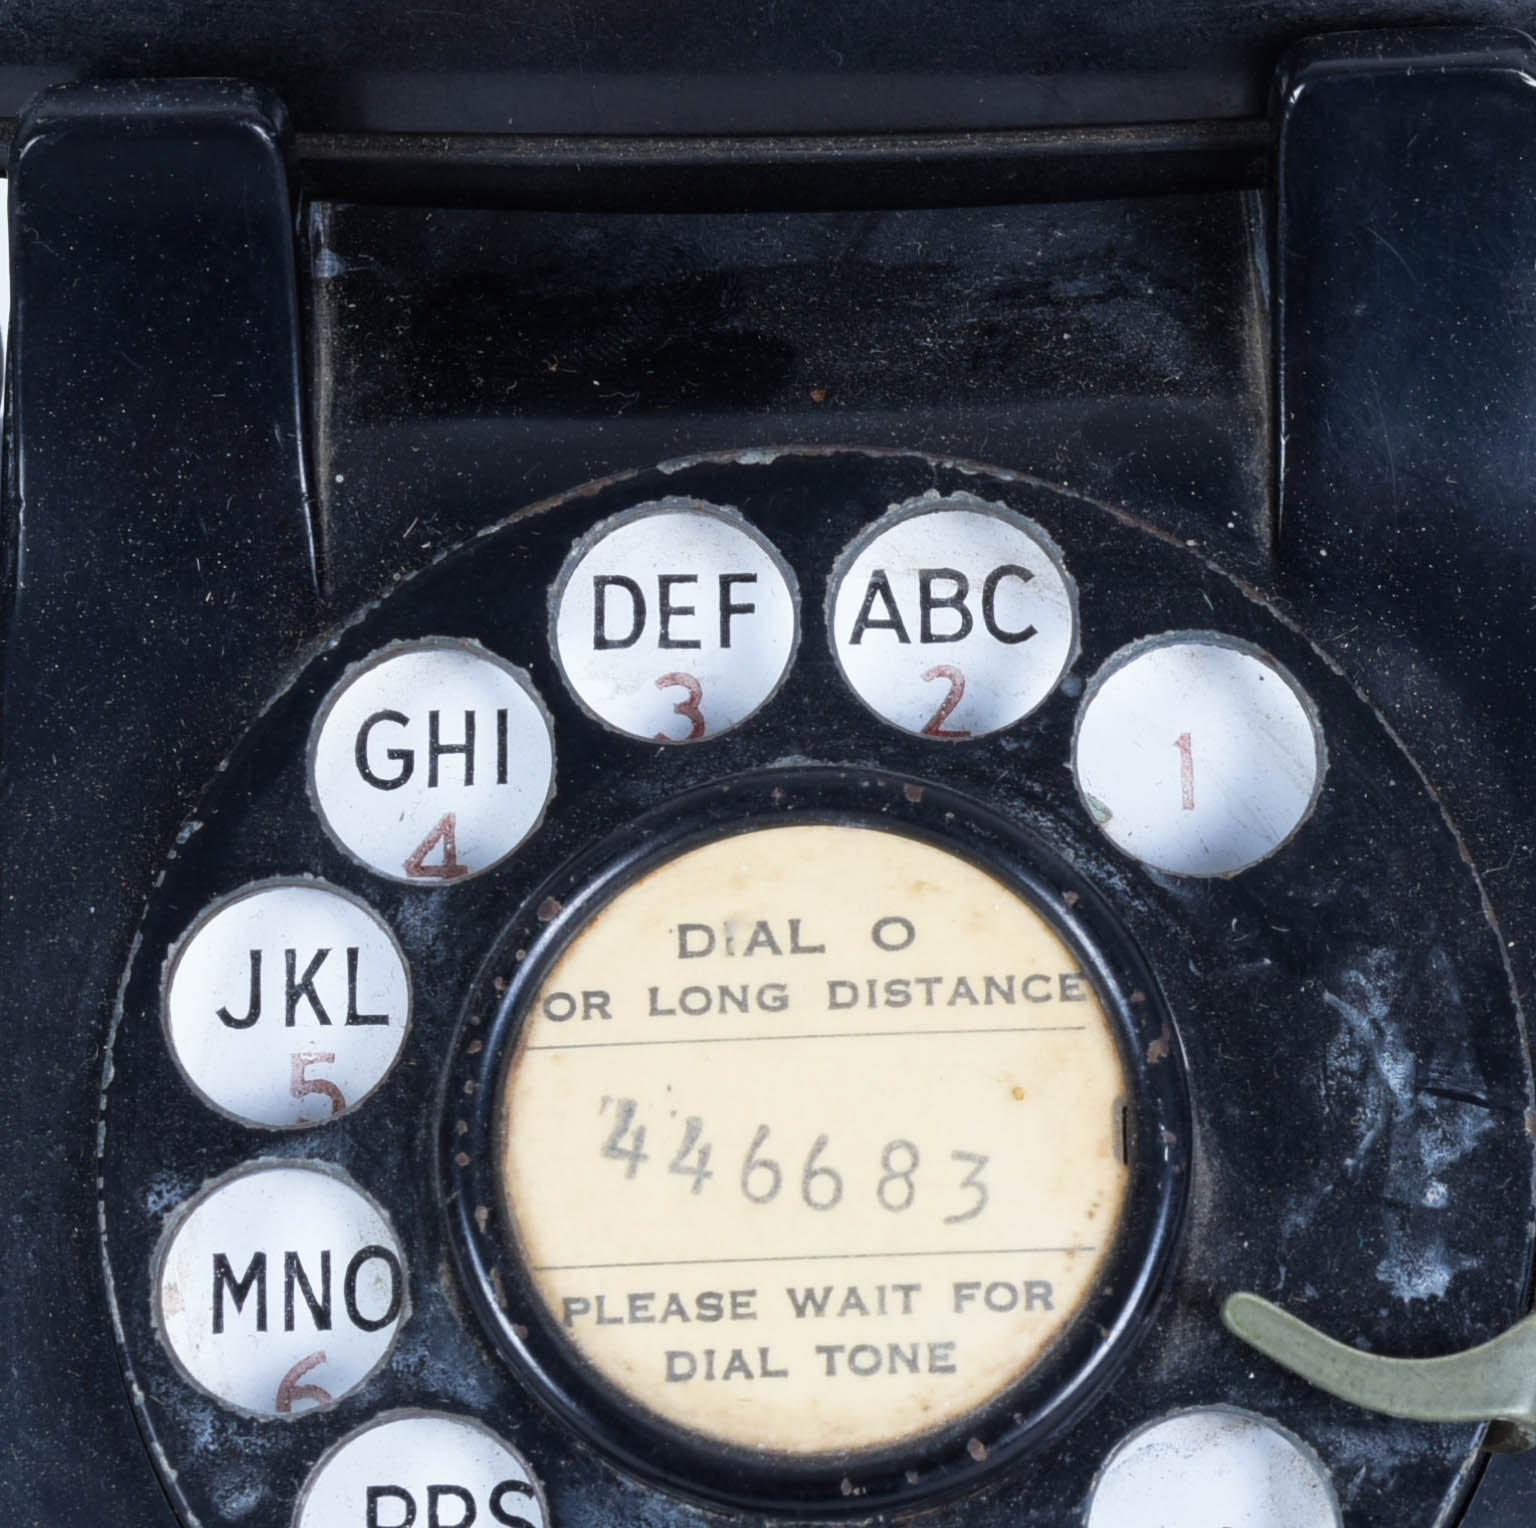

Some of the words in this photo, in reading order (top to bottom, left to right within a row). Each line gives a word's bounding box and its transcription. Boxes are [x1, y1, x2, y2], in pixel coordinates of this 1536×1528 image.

[593, 572, 758, 650] DEF
[849, 564, 1038, 646] ABC
[656, 672, 705, 741] 3
[921, 665, 971, 739] 2
[355, 708, 509, 792] GHI
[1173, 732, 1196, 812] 1
[403, 812, 469, 878] 4
[676, 918, 825, 960] DIAL
[216, 947, 390, 1030] JKL
[648, 983, 789, 1017] LONG
[827, 972, 1088, 1011] DISTANCE
[290, 1052, 346, 1124] 5
[600, 1096, 991, 1225] 446683
[212, 1244, 402, 1334] MNO
[563, 1289, 758, 1328] PLEASE
[786, 1284, 922, 1319] WAIT
[953, 1280, 1055, 1313] FOR
[275, 1350, 332, 1413] 6
[665, 1347, 789, 1383] DIAL
[815, 1341, 956, 1377] TONE
